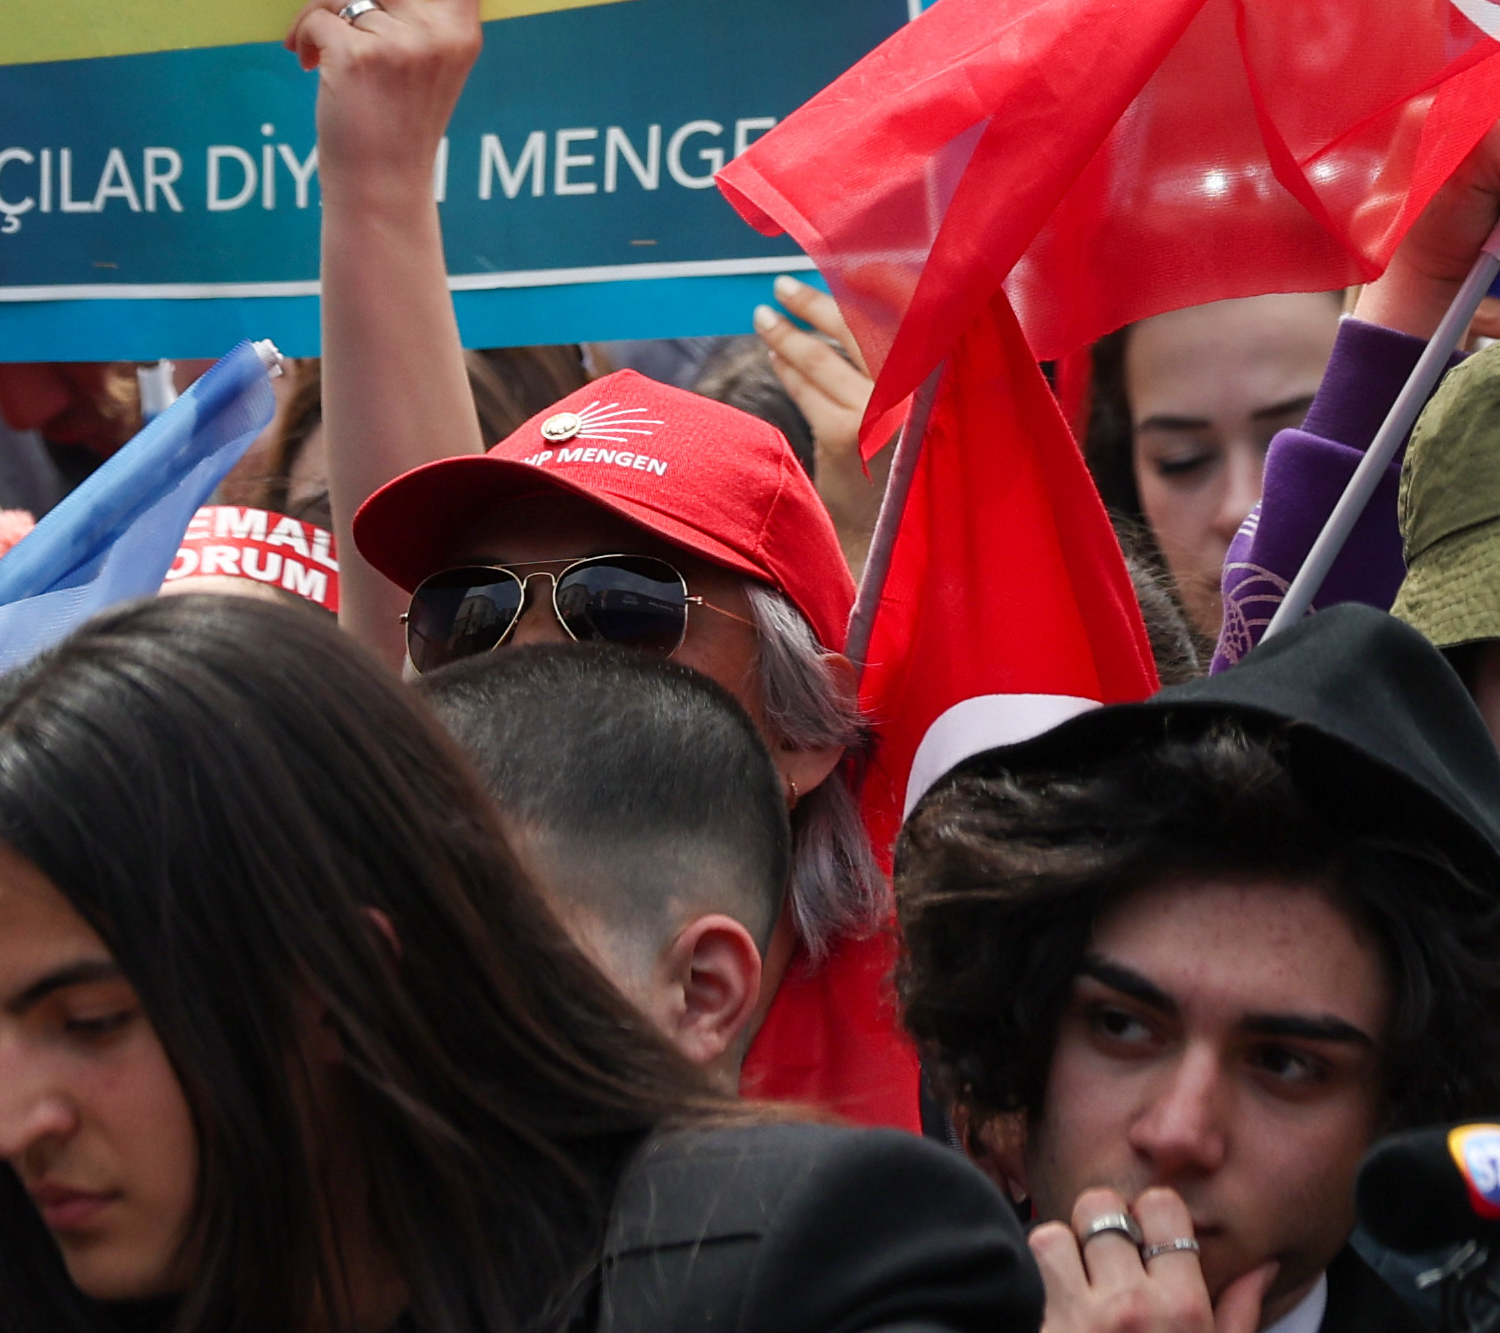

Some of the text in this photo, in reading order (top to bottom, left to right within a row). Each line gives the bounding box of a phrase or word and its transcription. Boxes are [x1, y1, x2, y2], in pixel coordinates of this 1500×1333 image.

[206, 122, 450, 213] DİYI
[477, 115, 780, 202] MENG
[520, 437, 668, 476] HP MENGEN
